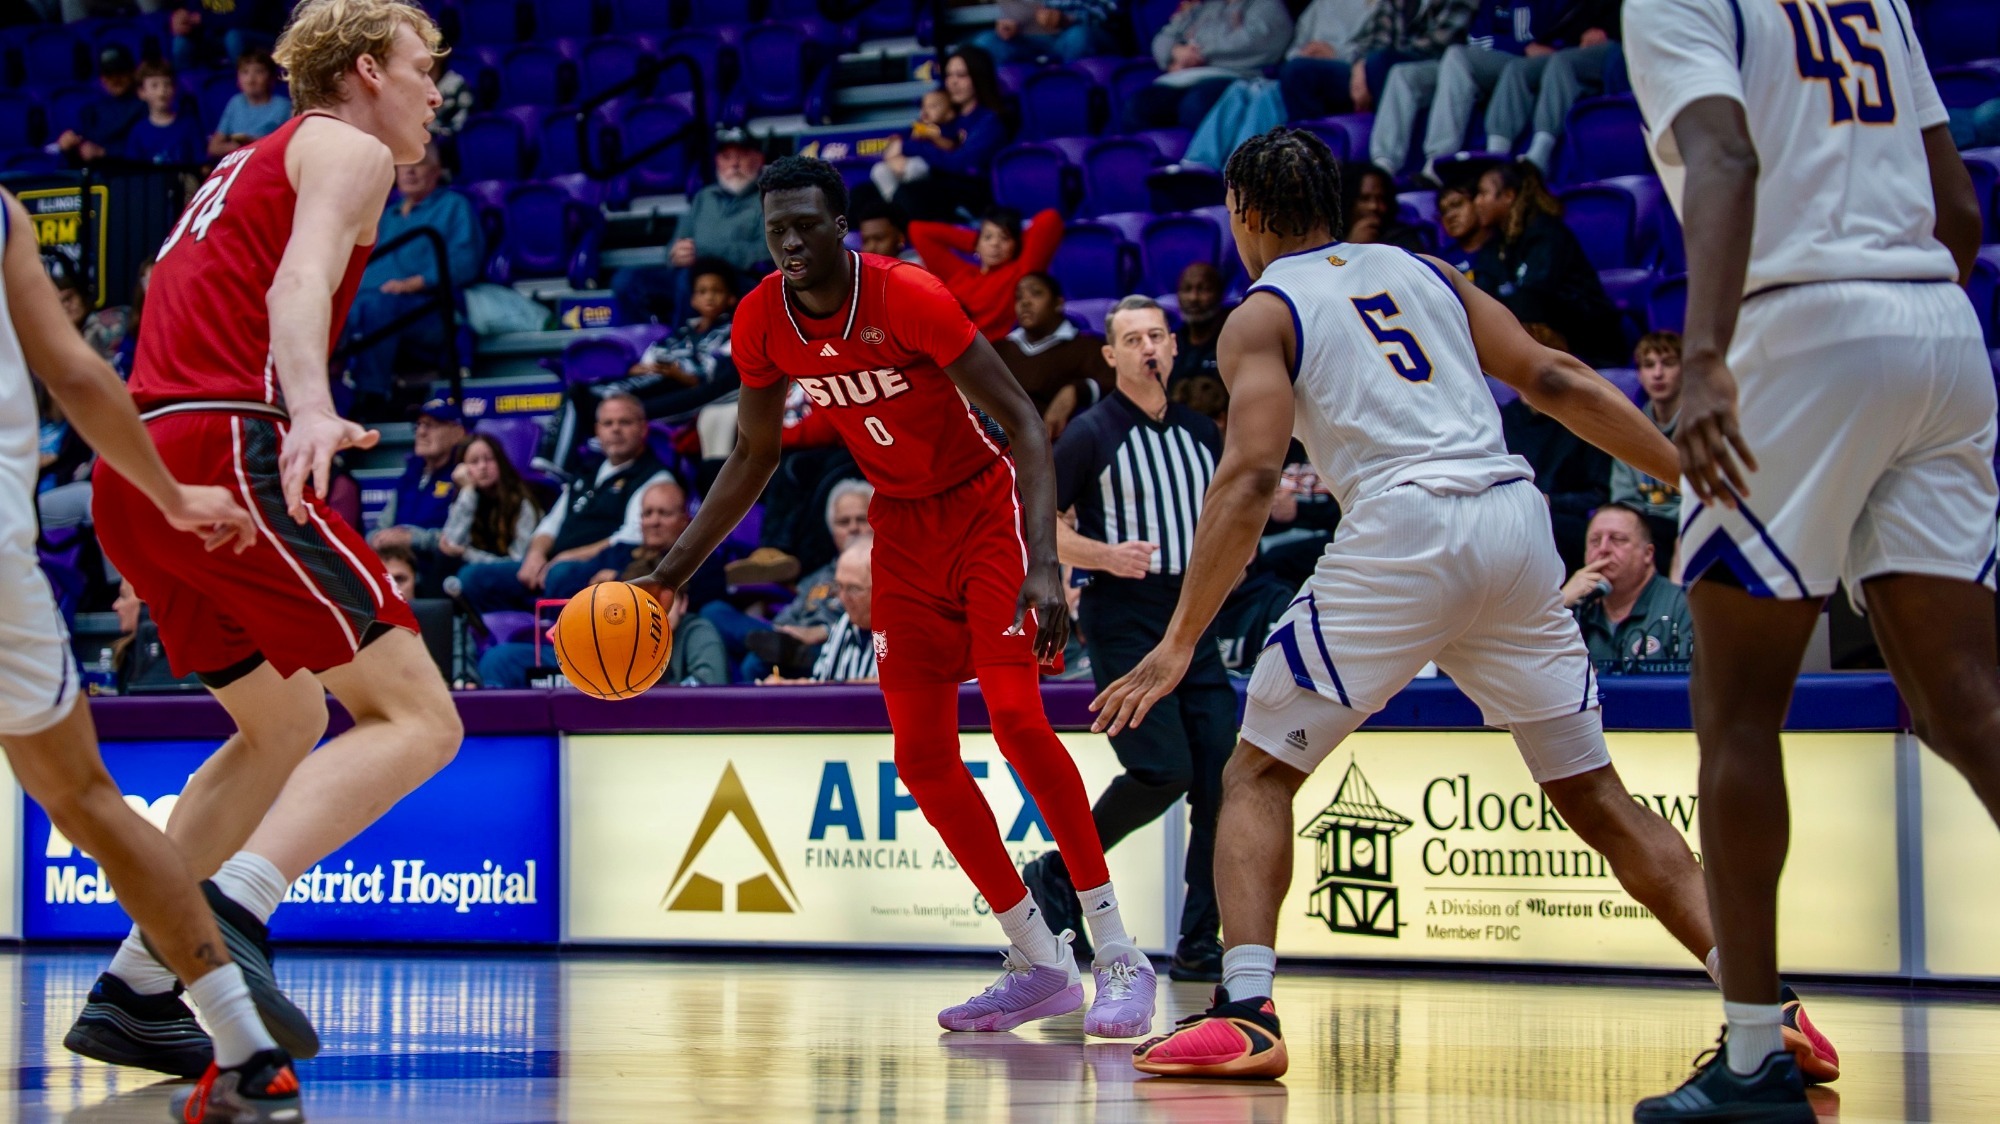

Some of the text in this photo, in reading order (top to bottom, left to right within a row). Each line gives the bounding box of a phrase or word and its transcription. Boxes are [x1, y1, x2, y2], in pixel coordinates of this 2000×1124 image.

[1778, 0, 1897, 127] 45
[1349, 289, 1434, 384] 5
[796, 366, 911, 408] SIUE
[864, 416, 894, 446] 0
[807, 760, 1056, 842] APX
[805, 848, 922, 869] FINANCIAL
[1422, 837, 1608, 878] Communi
[388, 859, 538, 913] Hospital
[1426, 900, 1437, 915] A
[1441, 899, 1501, 917] Division
[1505, 900, 1521, 916] of
[1526, 898, 1592, 918] Morton
[1426, 924, 1521, 940] Member FDIC
